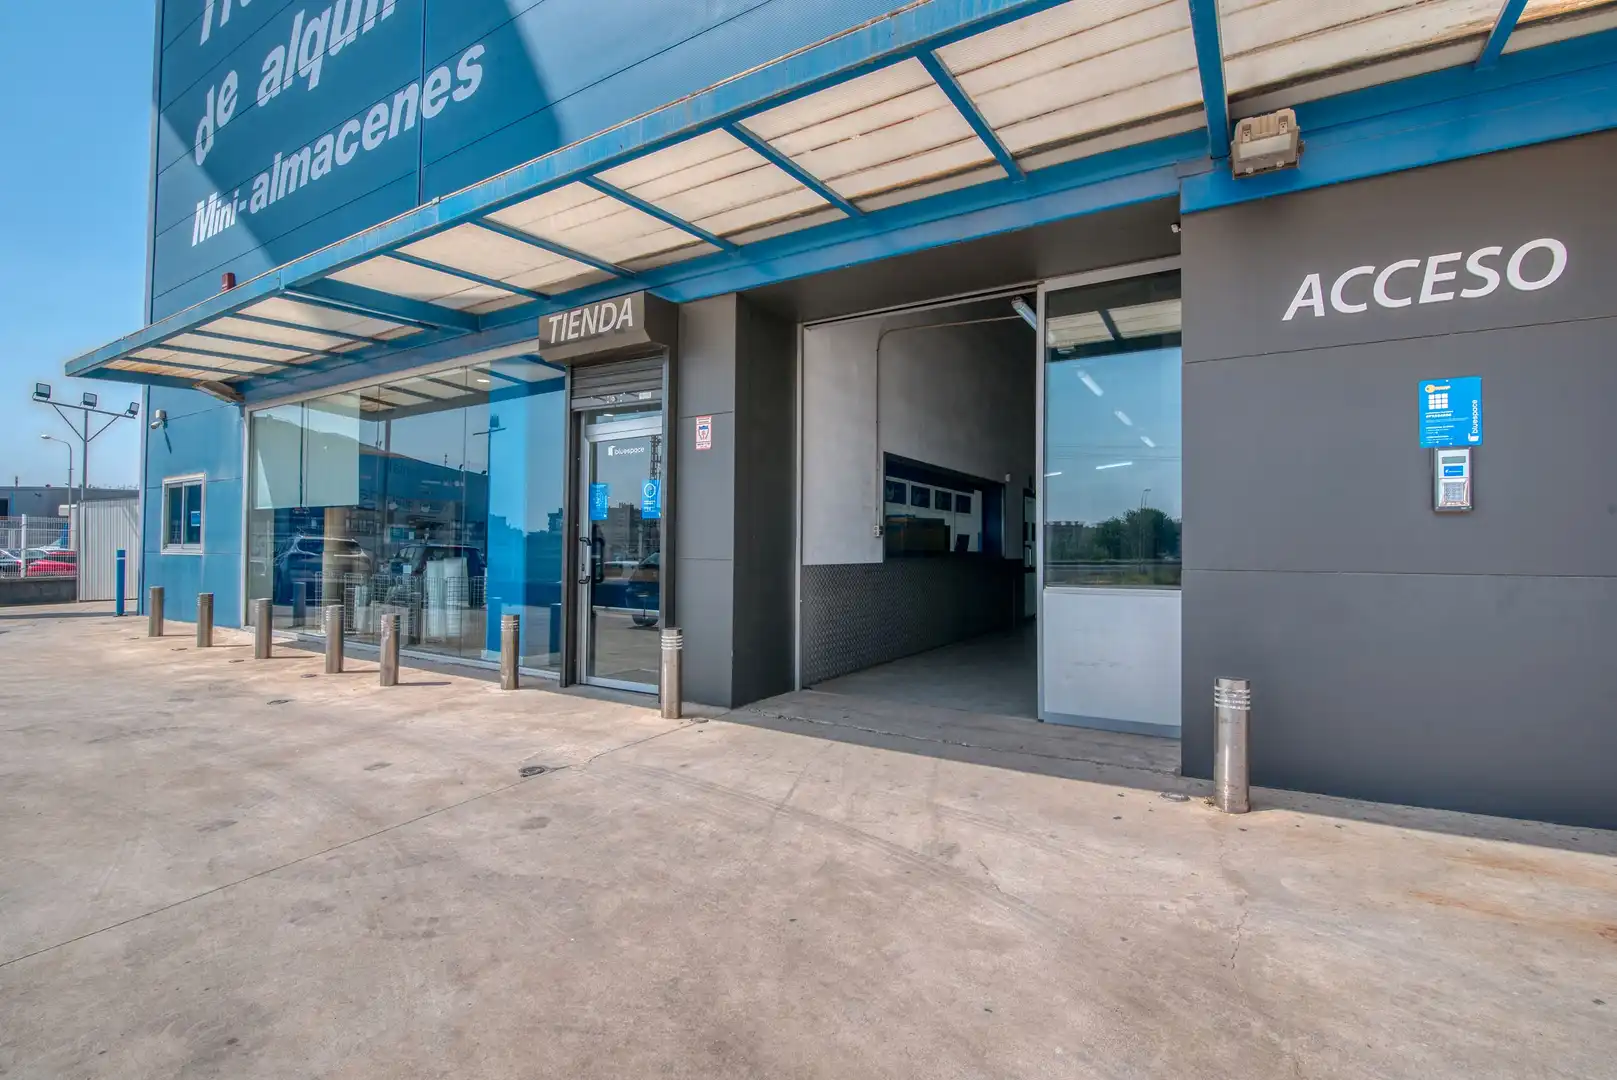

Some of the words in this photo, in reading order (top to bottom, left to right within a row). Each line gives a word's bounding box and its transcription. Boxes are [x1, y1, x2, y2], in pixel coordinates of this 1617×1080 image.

[195, 70, 237, 166] de
[257, 0, 397, 107] alqu
[191, 44, 485, 247] Mini-almacenes
[549, 298, 633, 344] TIENDA
[1282, 238, 1567, 321] ACCESO
[614, 446, 645, 455] bluespace
